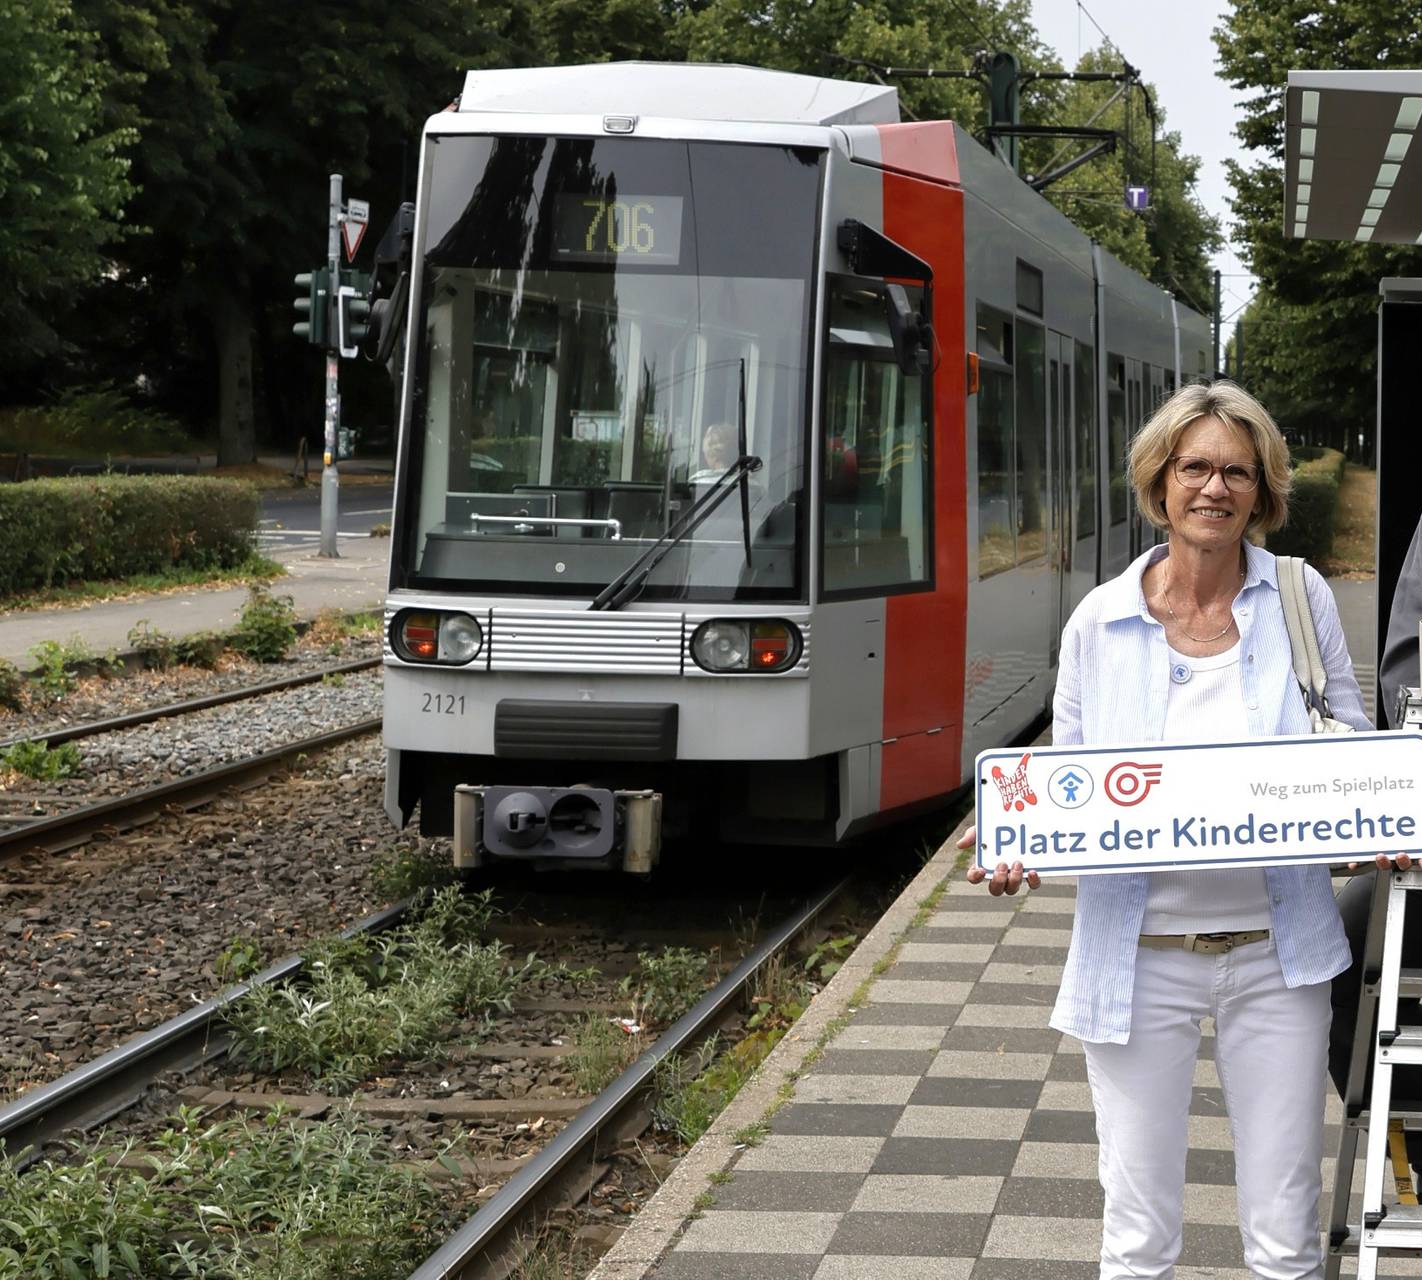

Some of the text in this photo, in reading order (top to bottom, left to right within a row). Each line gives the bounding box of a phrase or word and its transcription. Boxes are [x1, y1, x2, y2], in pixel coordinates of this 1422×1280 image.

[583, 201, 654, 252] 706
[422, 692, 465, 715] 2121
[1249, 776, 1415, 800] Weg zum Spielplatz
[995, 807, 1416, 857] Platz der Kinderrechte
